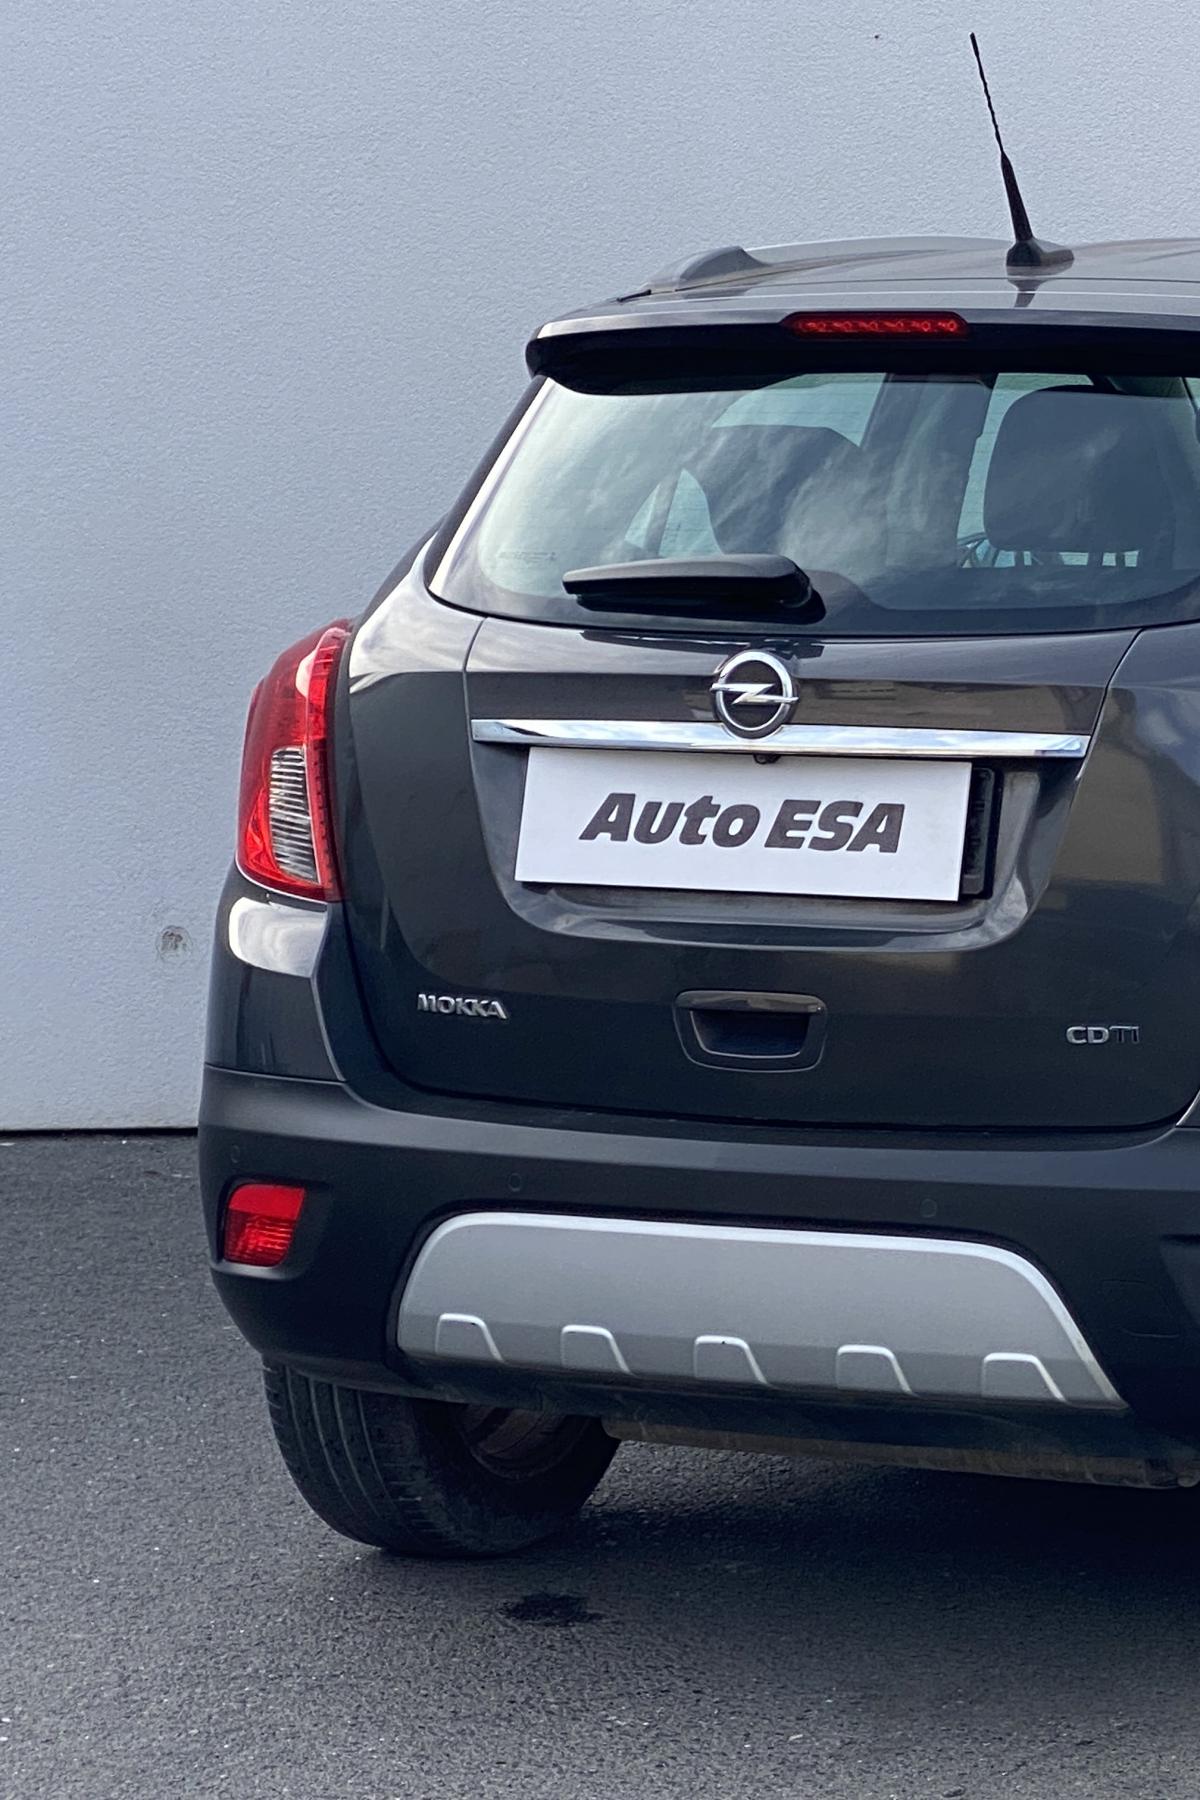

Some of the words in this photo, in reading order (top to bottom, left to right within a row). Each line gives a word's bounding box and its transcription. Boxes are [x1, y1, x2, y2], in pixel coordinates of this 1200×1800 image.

[578, 792, 761, 848] Auto
[764, 799, 906, 854] ESA
[416, 993, 508, 1020] MOKKA
